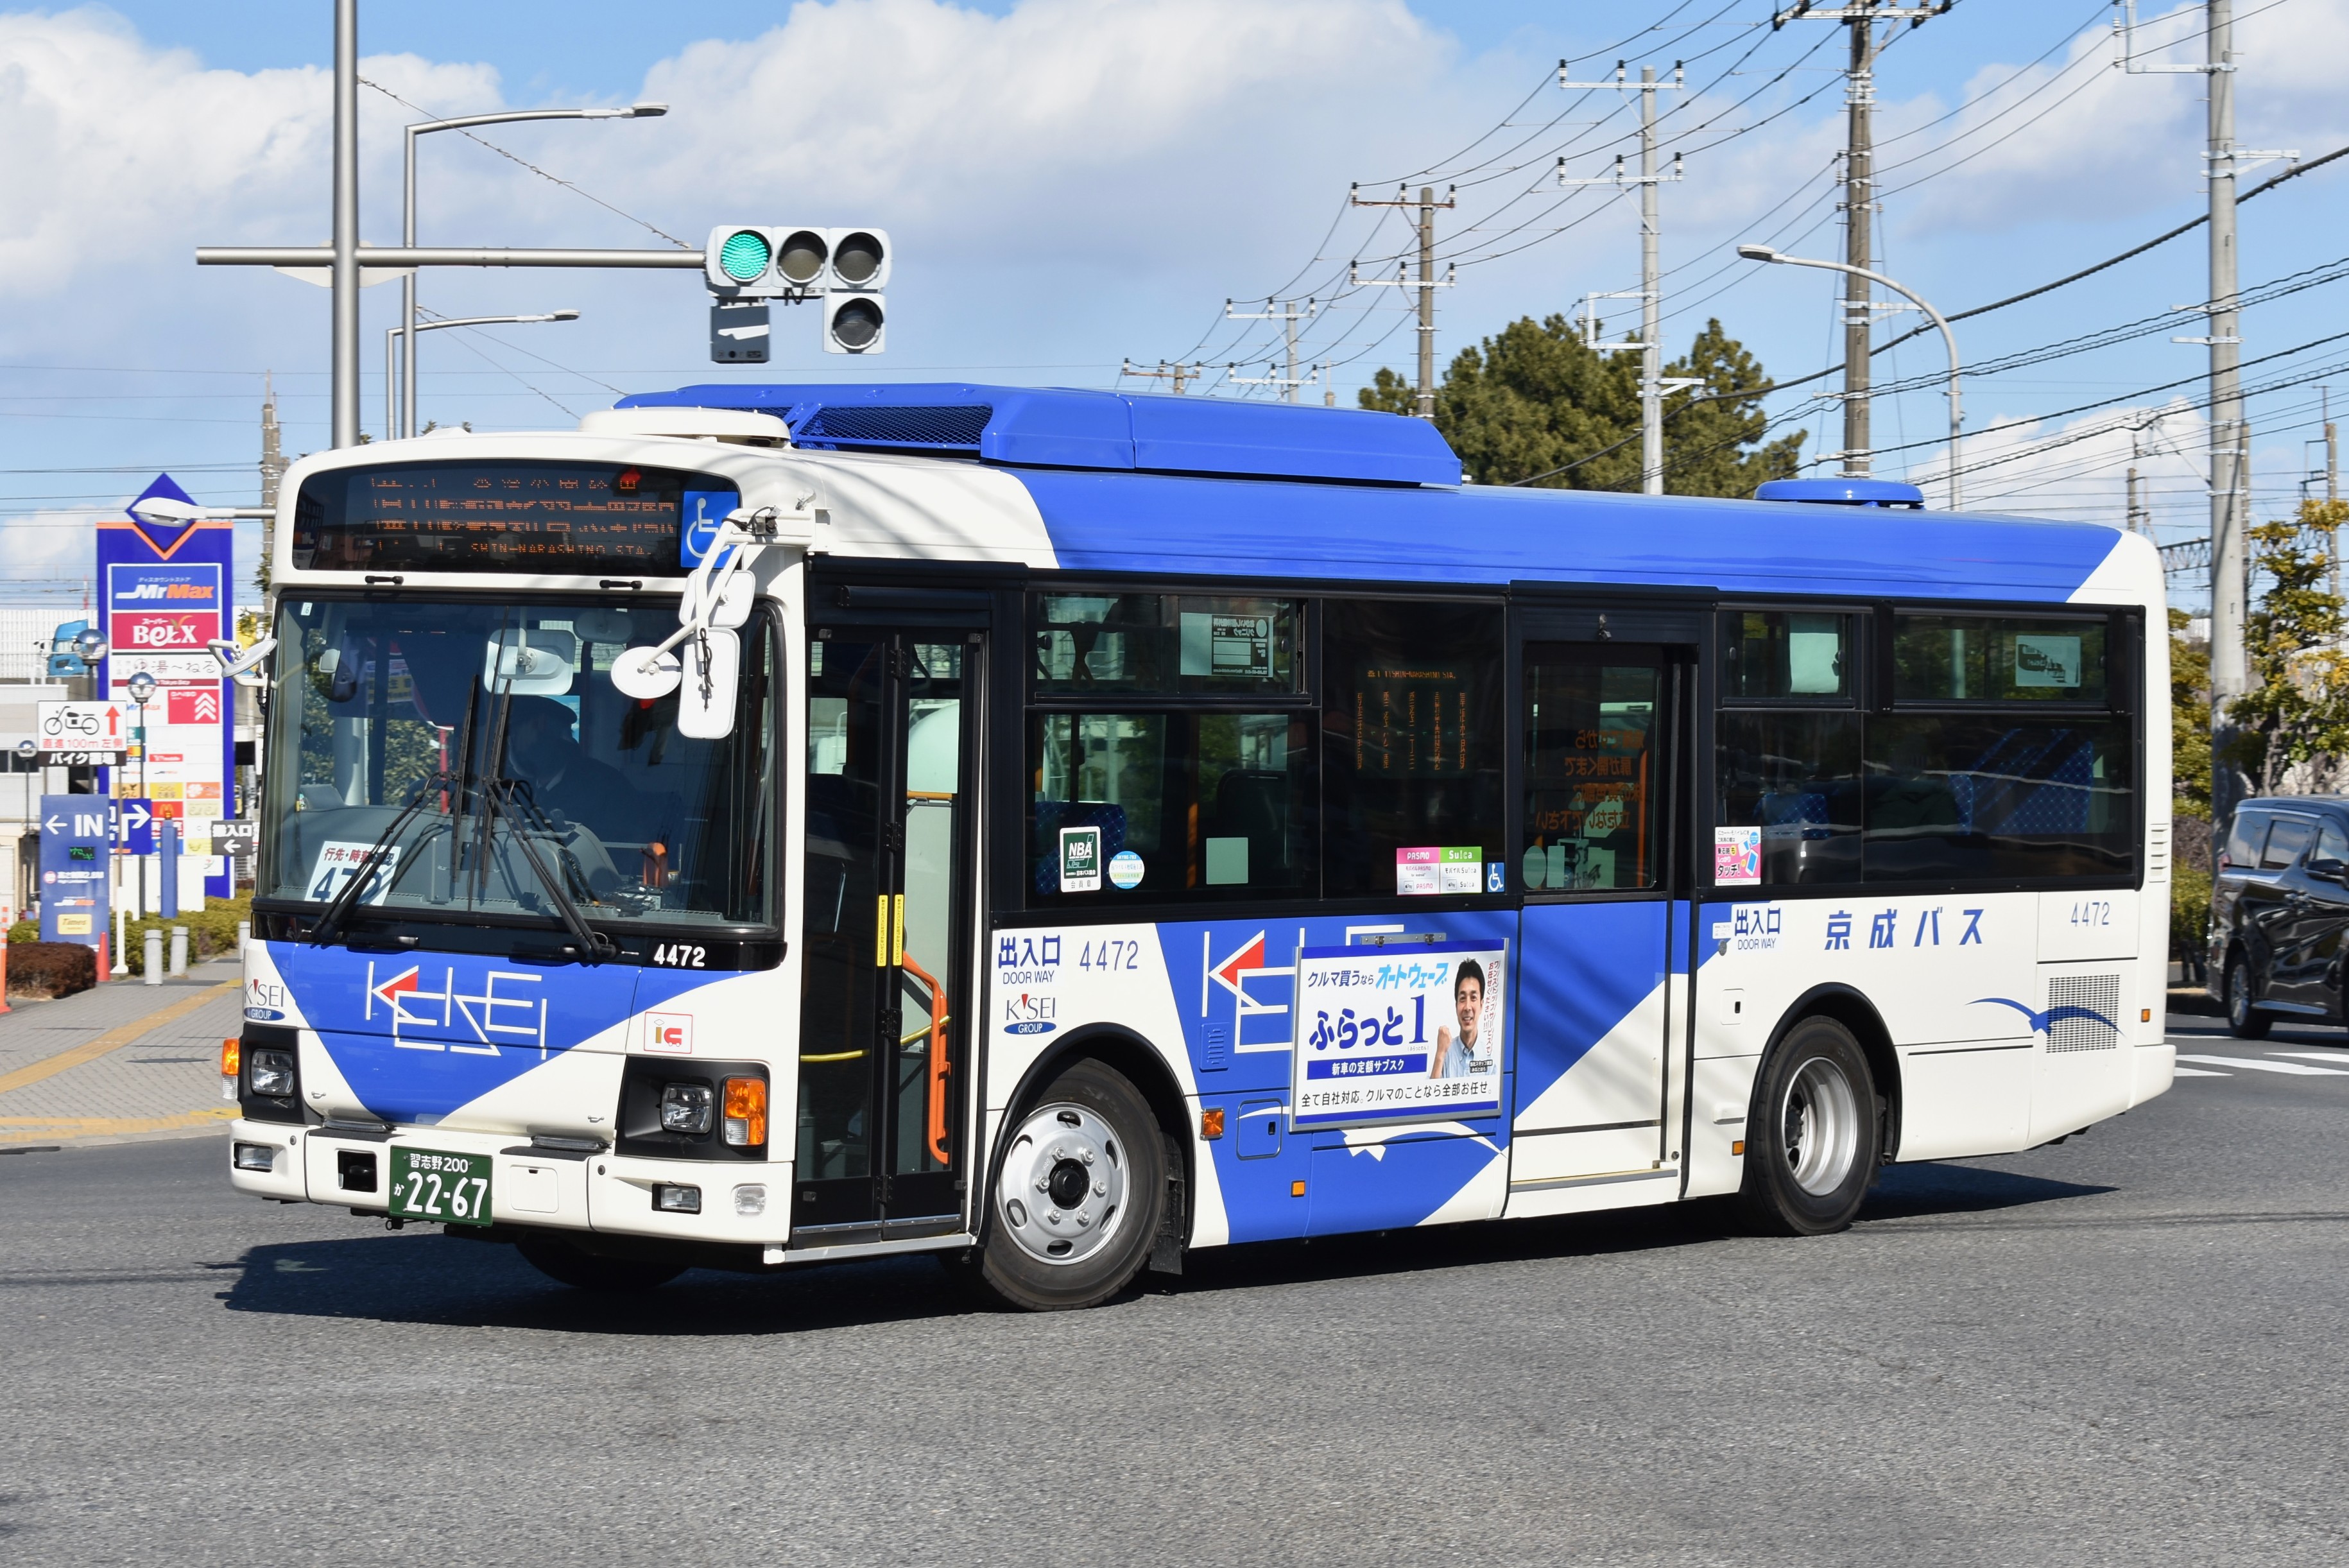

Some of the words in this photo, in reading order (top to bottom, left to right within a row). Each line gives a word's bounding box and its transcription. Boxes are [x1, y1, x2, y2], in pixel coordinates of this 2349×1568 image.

[116, 584, 215, 599] MrMax
[49, 752, 116, 765] バイク置場
[75, 814, 103, 836] IN
[1069, 841, 1092, 857] NBA
[1407, 852, 1430, 860] PASMO
[1449, 850, 1473, 859] Suica
[1734, 908, 1781, 936] 出入口
[2070, 902, 2110, 927] 4472
[1824, 906, 1984, 950] 京成バス
[998, 935, 1060, 969] 出入口
[1737, 938, 1760, 951] DOOR
[1760, 938, 1777, 949] WAY
[653, 943, 705, 967] 4472
[1080, 940, 1139, 972] 4472
[1002, 971, 1032, 985] DOOR
[1035, 970, 1055, 983] WAY
[1308, 970, 1374, 988] クルマ買うなら
[1375, 963, 1449, 990] オートウェーブ
[251, 1009, 272, 1020] GROUP
[1018, 1022, 1043, 1033] GROUP
[1332, 1058, 1405, 1076] 新車の定額サブスク
[393, 1183, 405, 1196] か
[407, 1171, 488, 1219] 22-67
